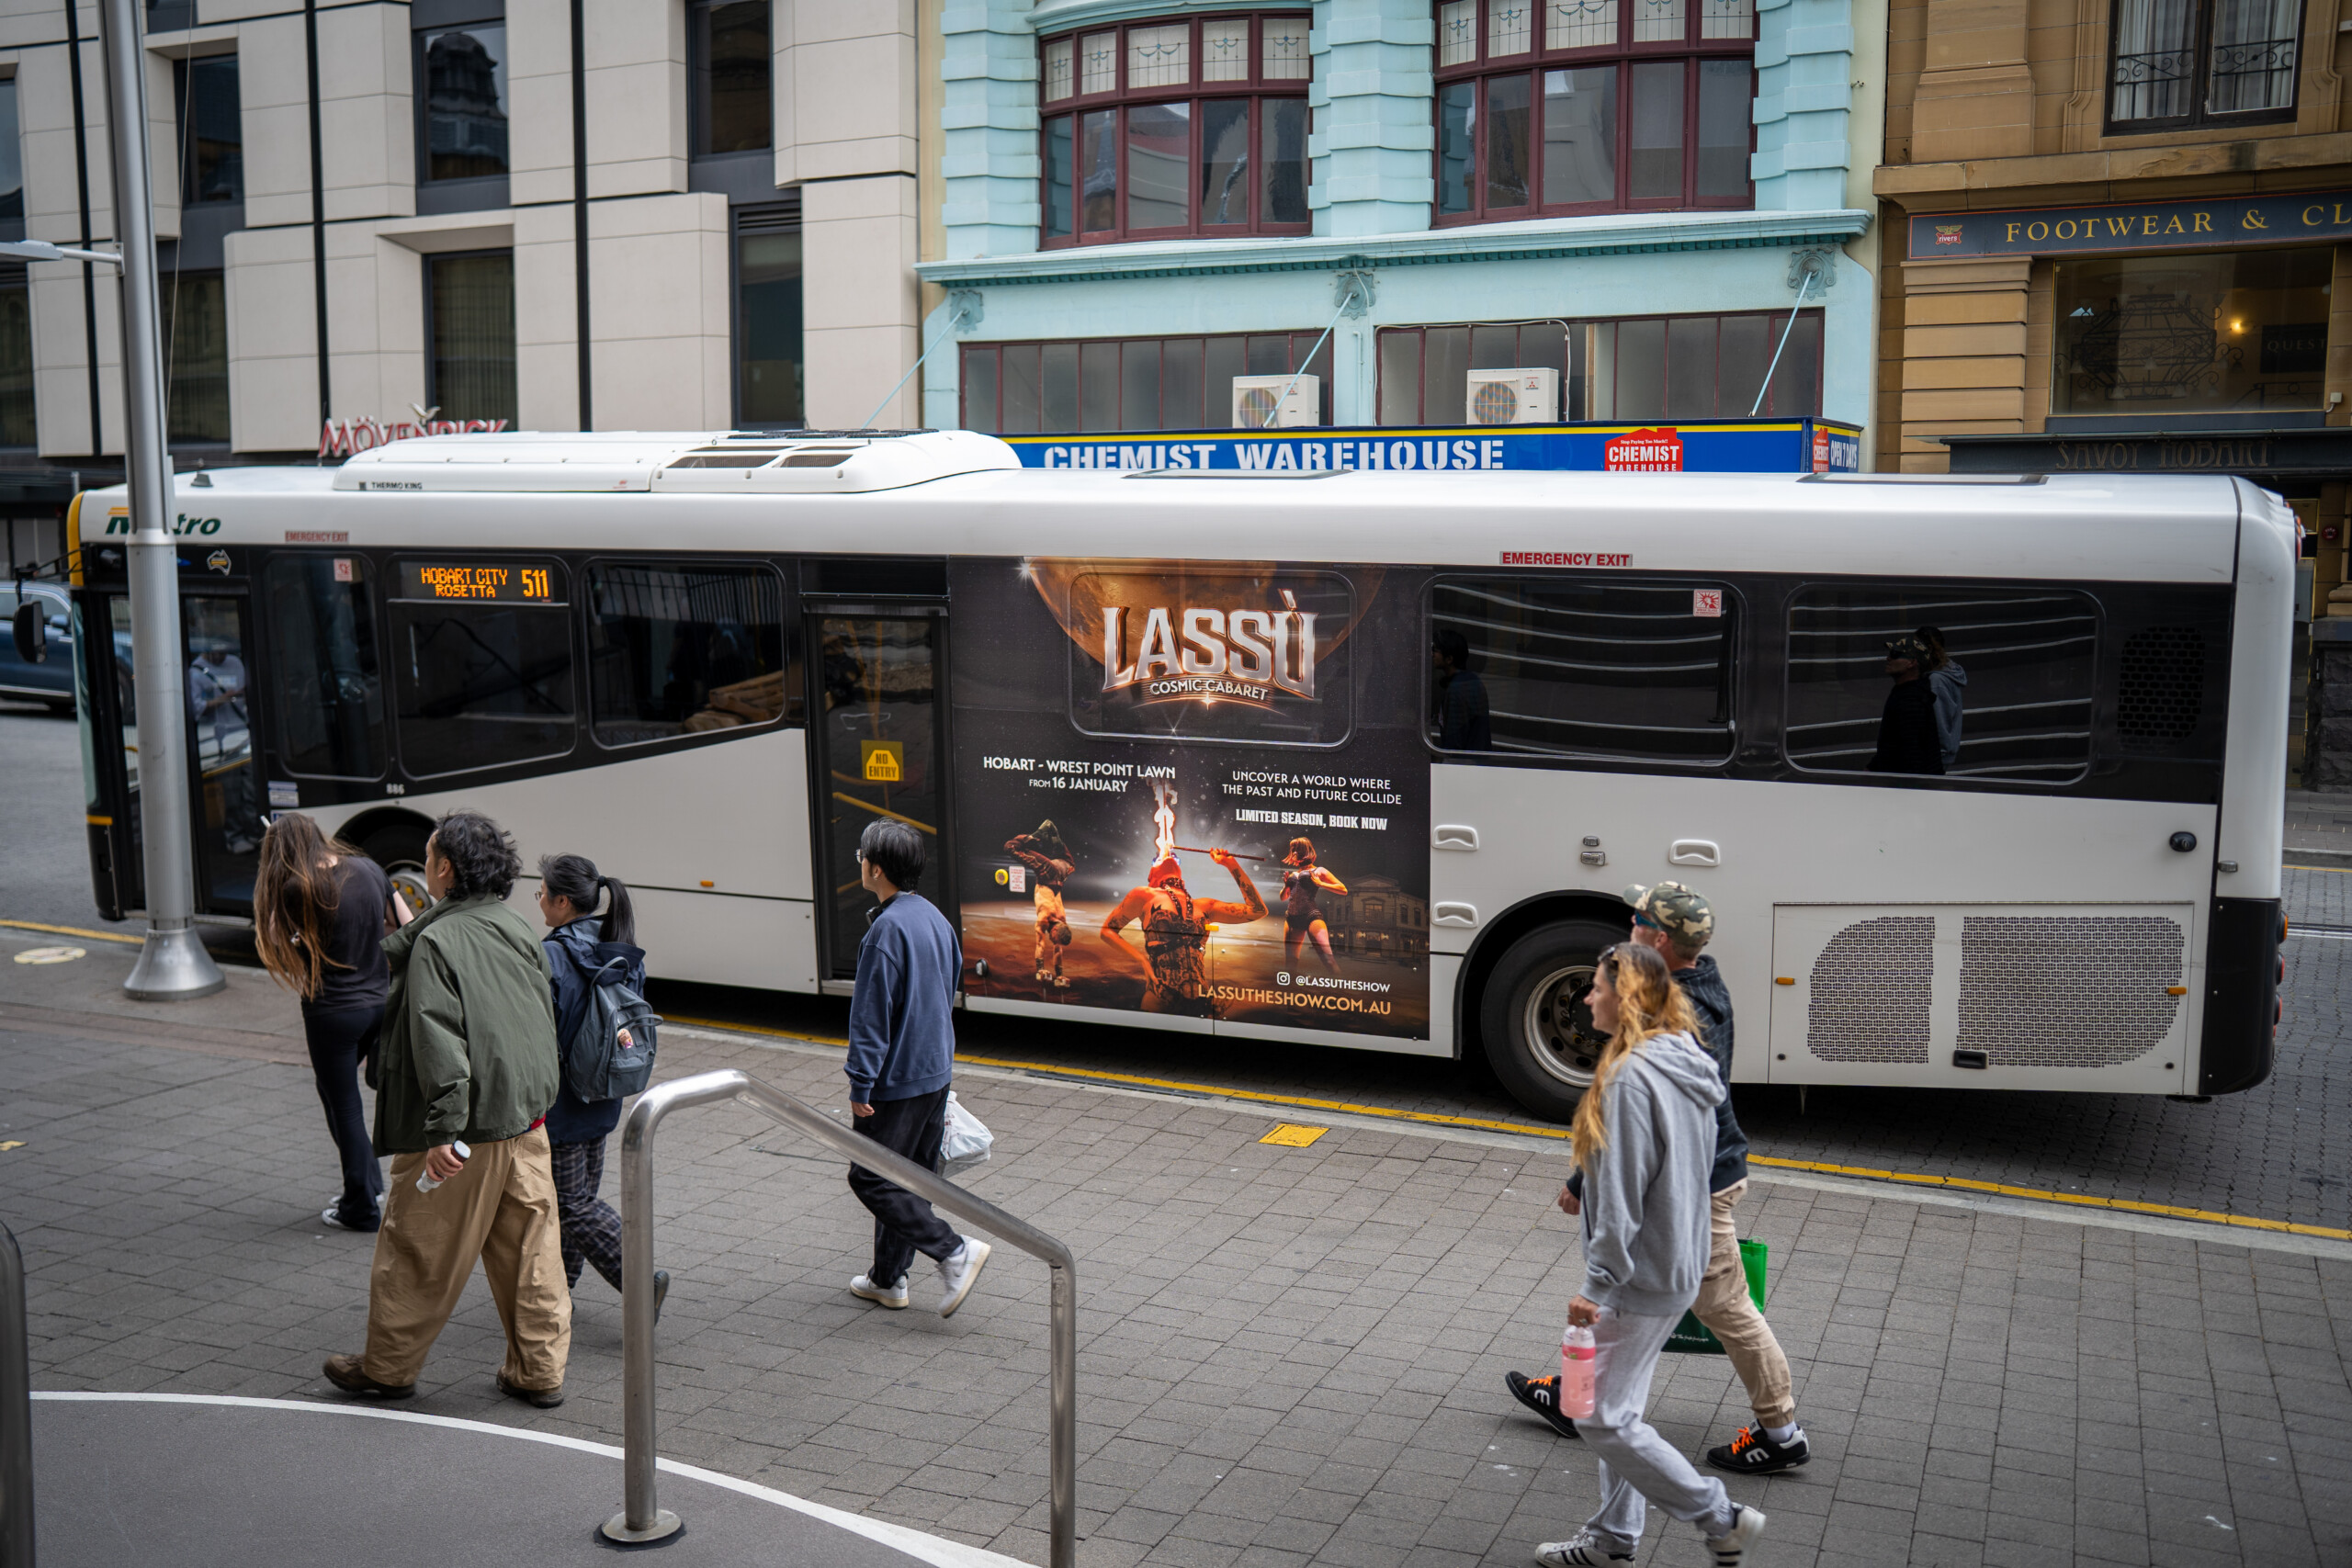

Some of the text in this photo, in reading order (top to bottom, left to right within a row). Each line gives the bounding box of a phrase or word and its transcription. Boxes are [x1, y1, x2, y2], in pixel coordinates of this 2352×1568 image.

[2006, 204, 2352, 243] FOOTWEAR & CL
[1939, 234, 1959, 243] rivers
[1044, 440, 1504, 470] CHEMIST WAREHOUSE
[1609, 446, 1680, 462] CHEMIST
[1830, 440, 1843, 467] OPEN
[2055, 439, 2273, 469] SAVOY HOBART
[1609, 463, 1677, 471] WAREHOUSE
[371, 481, 403, 490] THERMO
[105, 513, 221, 536] mtro
[285, 531, 349, 542] EMERGENCY EXIT
[1502, 552, 1630, 567] EMERGENCY EXIT
[421, 567, 508, 585] HOBART CITY
[521, 569, 549, 597] 511
[435, 584, 496, 598] ROSETTA
[1149, 679, 1269, 701] COSMIC CABARET
[876, 753, 888, 764] NO
[983, 756, 1036, 772] HOBART
[1046, 760, 1091, 774] WREST
[1093, 762, 1134, 777] POINT
[1136, 765, 1176, 779] LAWN
[868, 766, 897, 778] ENTRY
[1232, 771, 1391, 790] UNCOVER A WORLD WHERE
[386, 784, 405, 795] 886
[1028, 776, 1129, 793] FROM 16 JANUARY
[1222, 784, 1402, 805] THE PAST AND FUTURE COLLIDE
[1236, 808, 1388, 831] LIMITED SEASON, BOOK NOW
[1295, 976, 1391, 993] @LASSUTHESHOW
[1198, 984, 1392, 1015] LASSUTHESHOW.COM.AU
